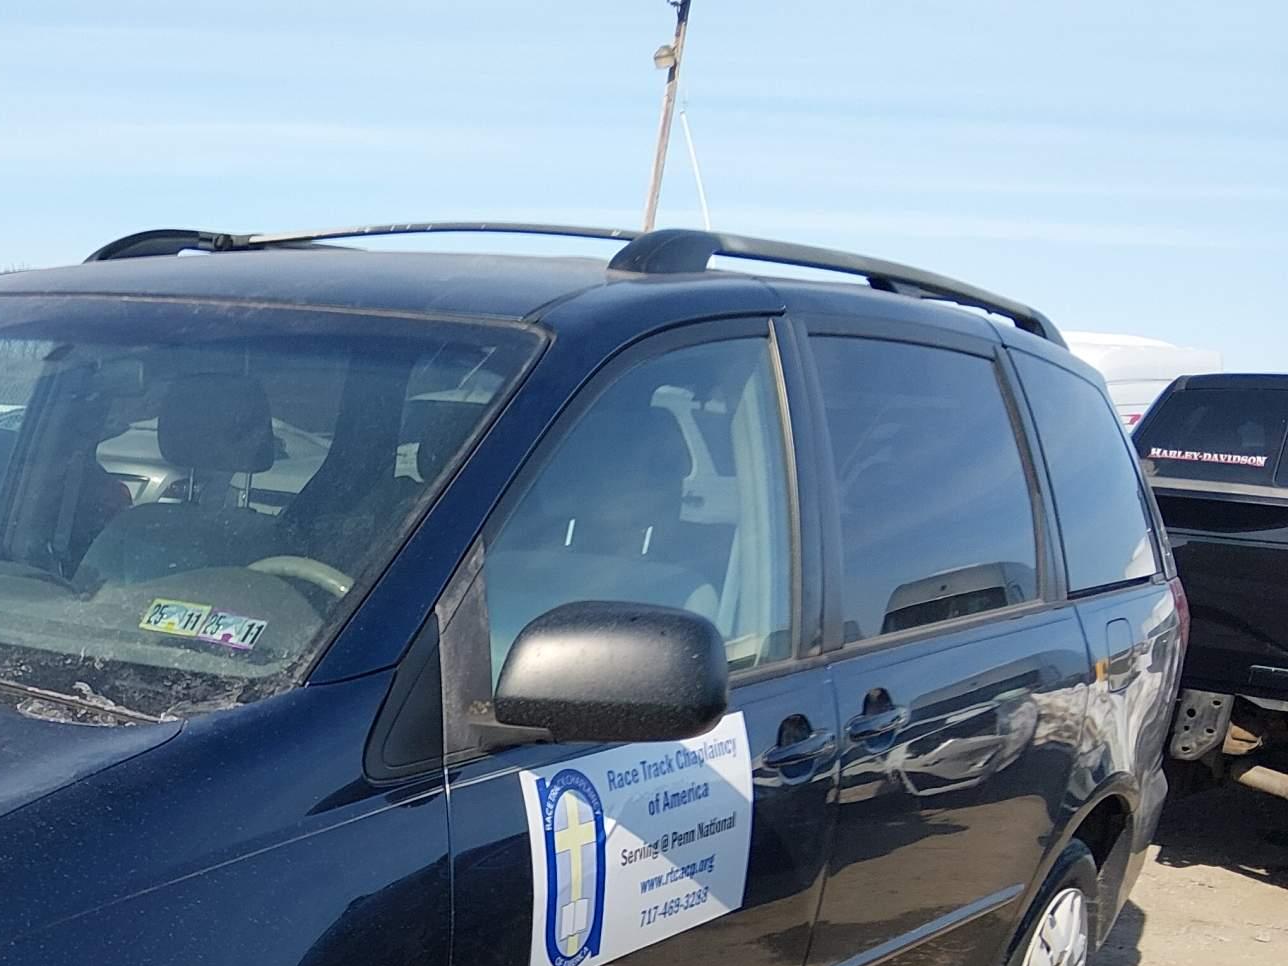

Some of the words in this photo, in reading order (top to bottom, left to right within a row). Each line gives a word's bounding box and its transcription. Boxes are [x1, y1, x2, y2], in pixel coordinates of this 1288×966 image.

[1149, 447, 1267, 467] HARLEY-DAVIDSON
[147, 604, 168, 625] 25
[203, 614, 226, 636] 25
[607, 768, 639, 792] Race
[639, 754, 674, 781] Track
[675, 738, 737, 771] Chaplaincy
[648, 793, 661, 816] of
[662, 782, 710, 812] America
[621, 839, 660, 867] Serving
[661, 833, 669, 853] @
[671, 829, 695, 850] Penn
[697, 811, 737, 841] National
